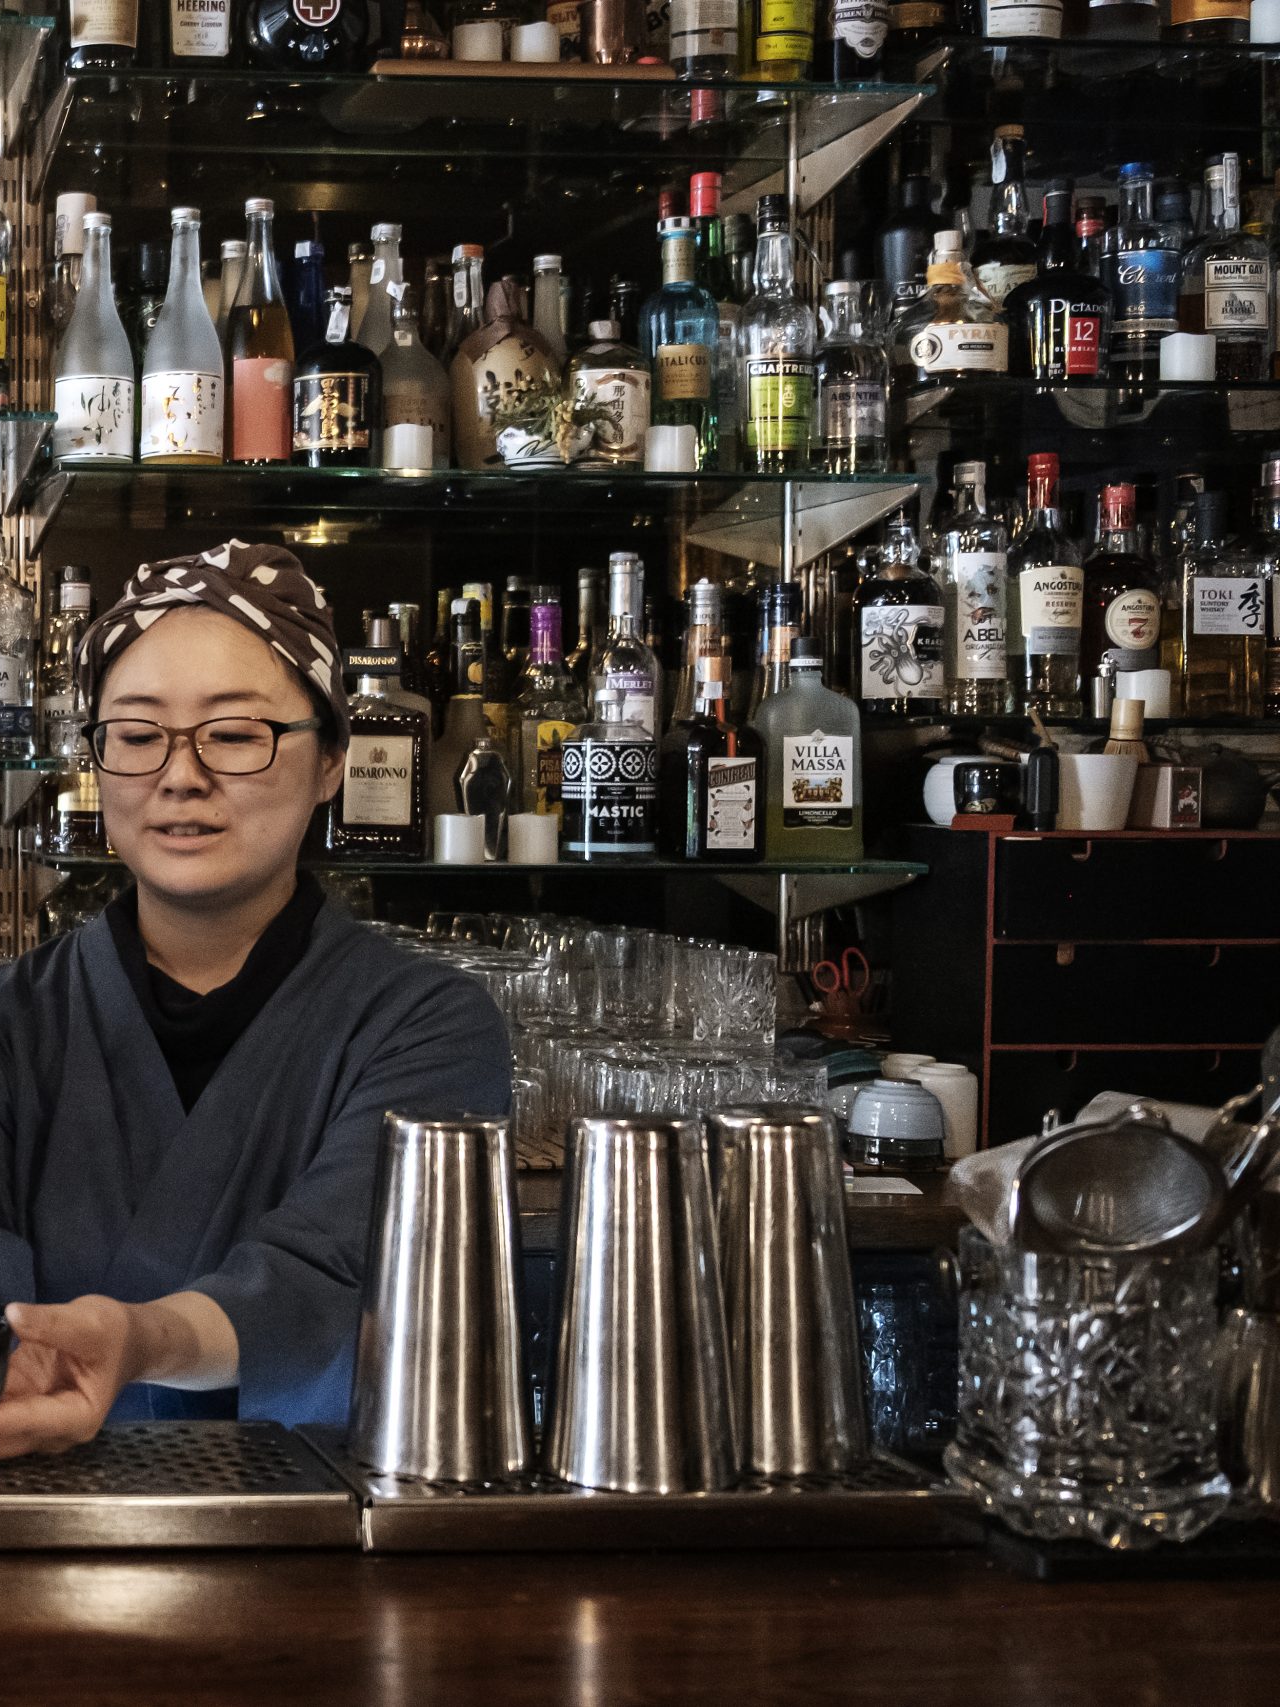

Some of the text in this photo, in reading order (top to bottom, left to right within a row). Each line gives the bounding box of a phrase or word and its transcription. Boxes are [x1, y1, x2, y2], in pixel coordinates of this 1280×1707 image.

[177, 0, 225, 12] HEERING
[288, 39, 340, 53] ZWACK
[1214, 265, 1264, 275] MOUNT GAY
[948, 328, 998, 340] PYRAT
[1074, 321, 1094, 341] 12
[660, 355, 707, 367] ITALICUS
[831, 391, 881, 402] ABSINTHE
[1200, 589, 1233, 600] TOKI
[349, 656, 397, 666] DISARONNO
[795, 745, 841, 758] VILLA
[791, 758, 845, 771] MASSA
[349, 766, 407, 780] DISARONNO
[709, 763, 755, 788] COINTREAU
[588, 805, 644, 817] MASTIC
[798, 809, 838, 817] LIMONCELLO
[599, 818, 646, 827] EARS
